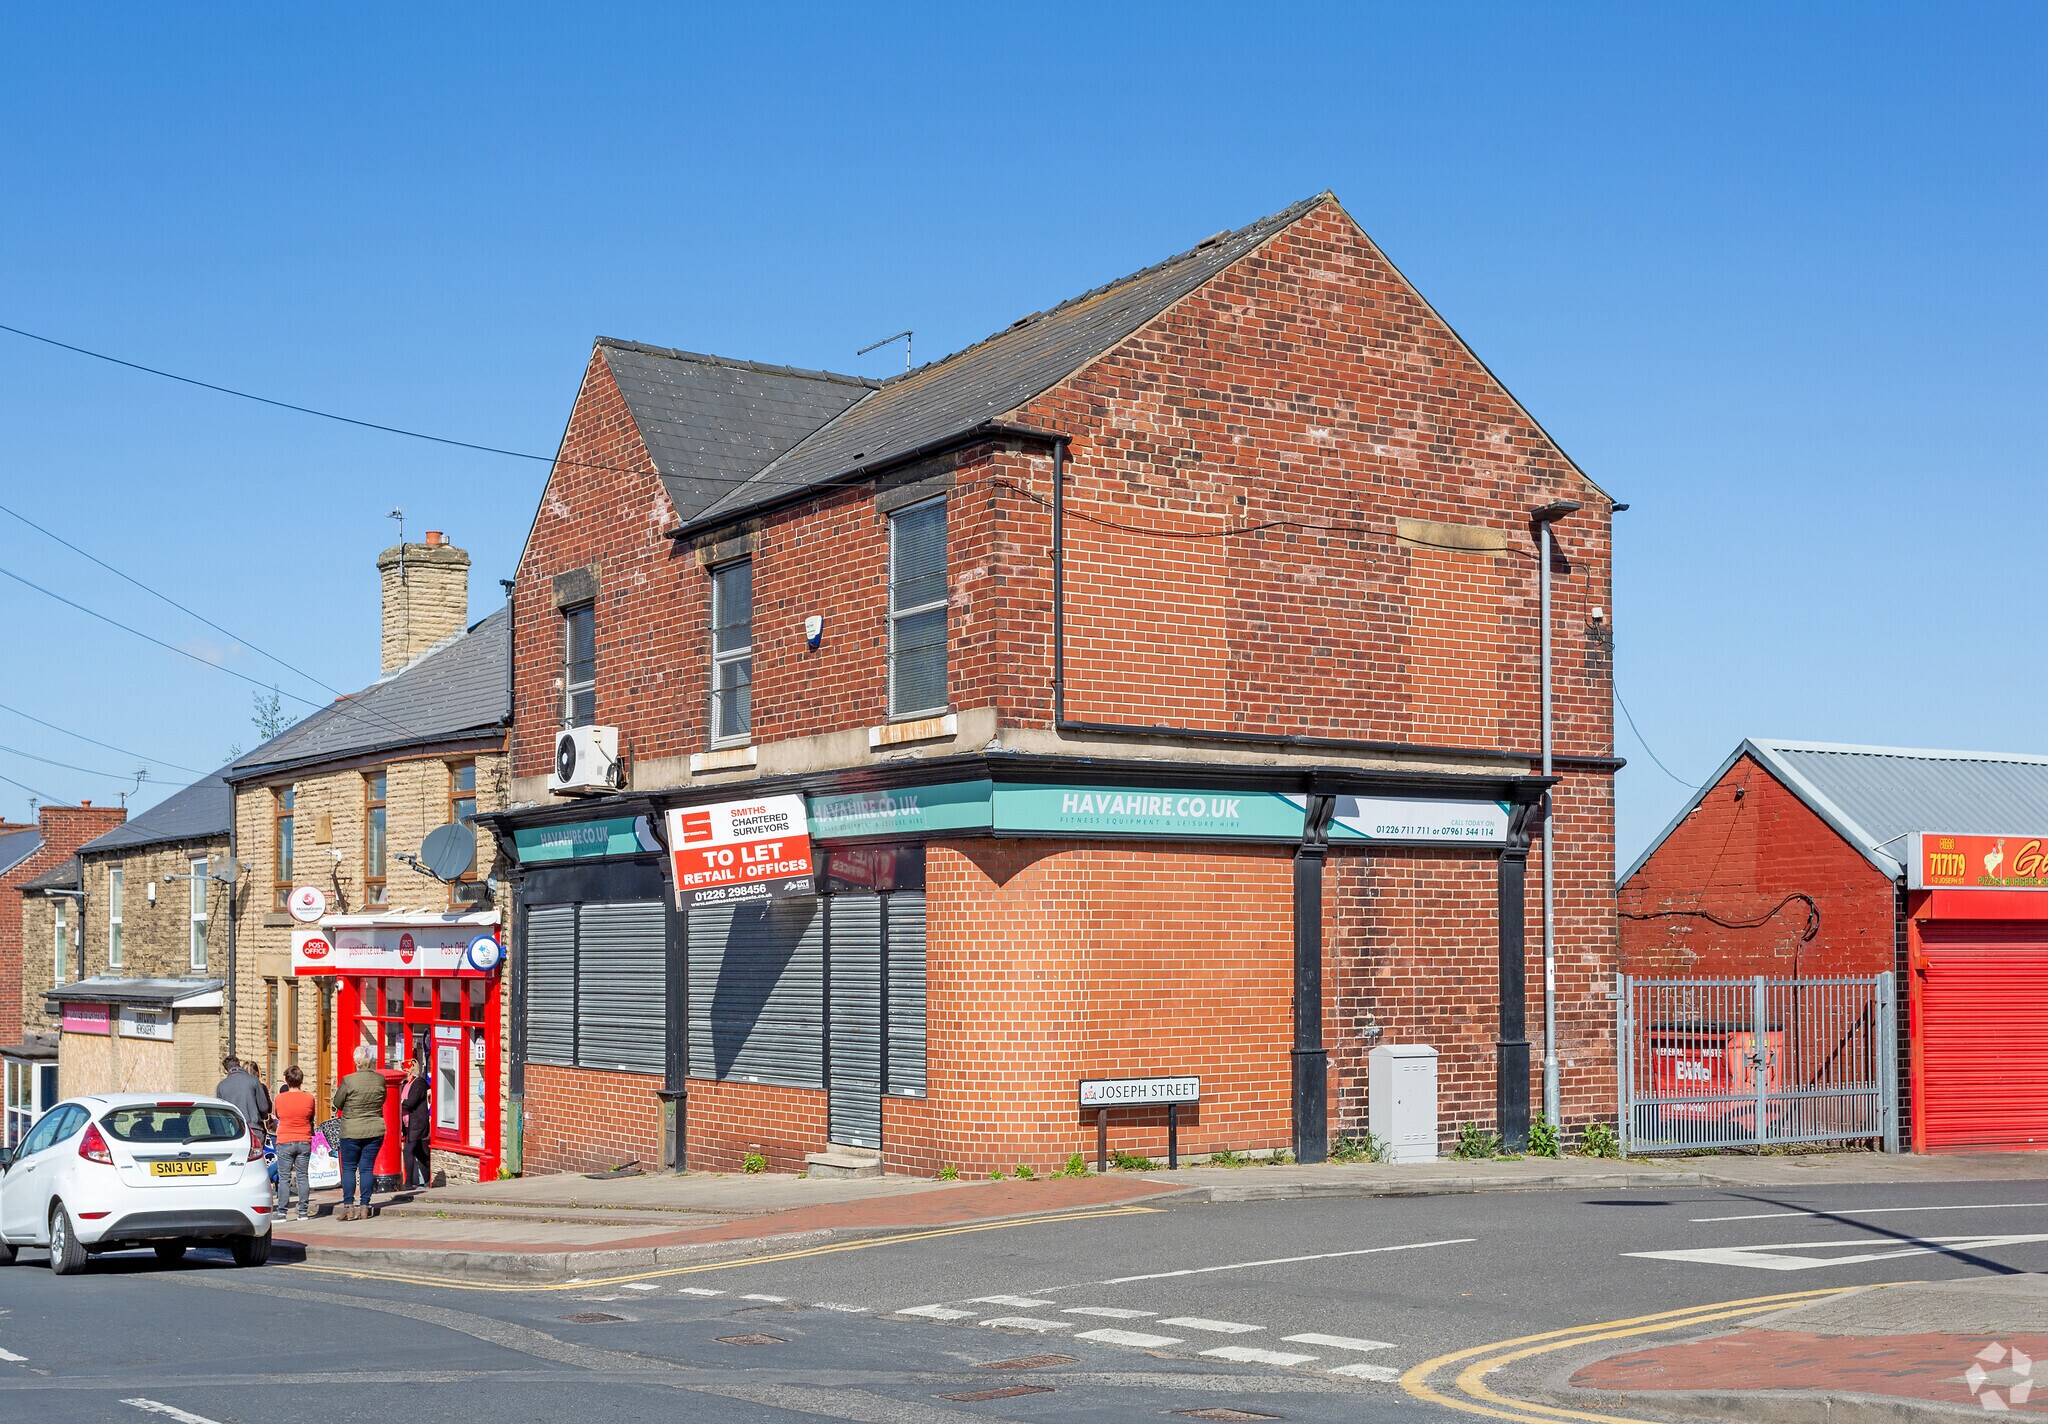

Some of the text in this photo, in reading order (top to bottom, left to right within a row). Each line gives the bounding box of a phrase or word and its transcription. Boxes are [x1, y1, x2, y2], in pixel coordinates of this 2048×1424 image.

[731, 806, 766, 817] SMITHS
[812, 795, 921, 823] HAVAHIRE.CO.UK
[1062, 793, 1240, 819] HAVAHIRE.CO.UK
[732, 813, 788, 827] CHARTERED
[882, 820, 905, 828] LEISURE
[1106, 818, 1160, 826] EQUIPMENT
[1177, 820, 1214, 828] LEISURE
[1451, 819, 1464, 827] CALL
[1465, 819, 1483, 827] TODAY
[733, 822, 789, 836] SURVEYORS
[1376, 825, 1399, 834] 01226
[1401, 826, 1415, 835] 711
[1416, 826, 1430, 835] 711
[1442, 827, 1463, 836] 07961
[1465, 827, 1479, 836] 544
[1481, 828, 1494, 836] 114
[540, 827, 609, 848] HAVAHIRE.CO.UK
[702, 842, 783, 868] TO LET
[1930, 852, 1966, 876] 717179
[683, 868, 735, 885] RETAIL
[746, 859, 808, 877] OFFICES
[1978, 876, 2001, 887] PIZZAS
[2005, 878, 2038, 887] BURGERS
[695, 883, 766, 902] 01226 298456
[402, 939, 412, 948] POST
[441, 942, 454, 955] Post
[1099, 1083, 1197, 1099] JOSEPH STREET
[156, 1162, 209, 1174] SN13 VGF
